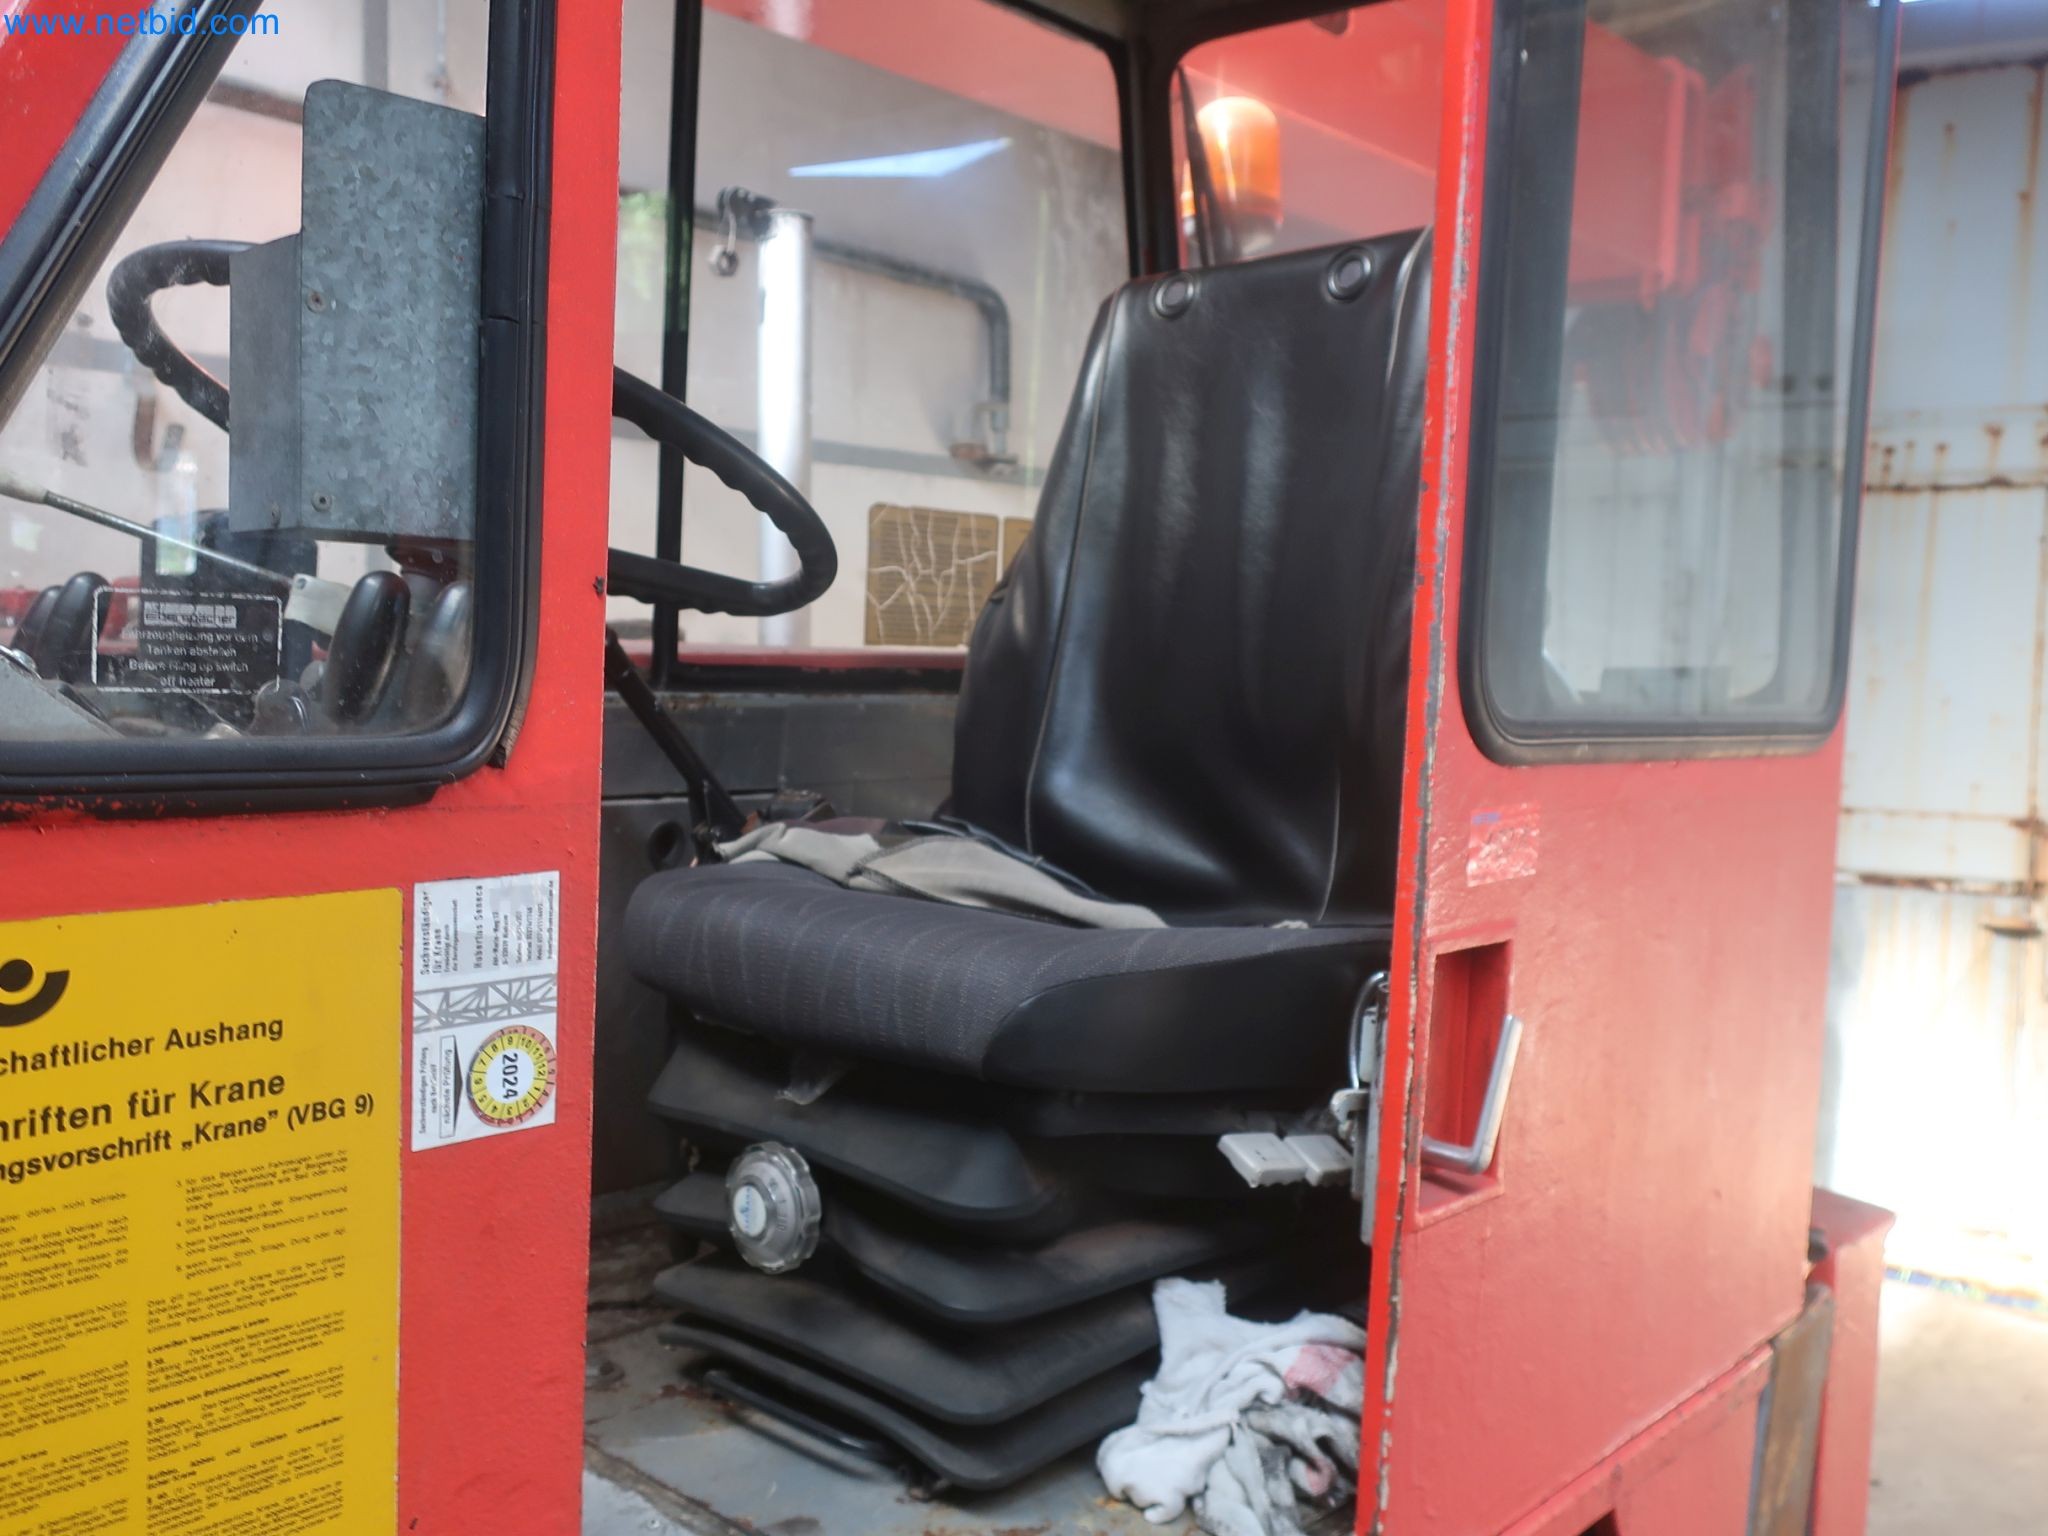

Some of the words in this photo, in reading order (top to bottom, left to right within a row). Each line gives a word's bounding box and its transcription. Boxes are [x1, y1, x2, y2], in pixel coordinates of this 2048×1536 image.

[148, 644, 187, 657] Tanken
[216, 661, 249, 672] switch
[160, 675, 176, 687] off
[179, 674, 216, 687] heater
[165, 1019, 283, 1051] Aushang
[502, 1053, 519, 1099] 2024
[128, 1089, 176, 1120] für
[190, 1074, 285, 1109] Krane
[287, 1099, 346, 1131] (VBG
[355, 1093, 374, 1117] 9)
